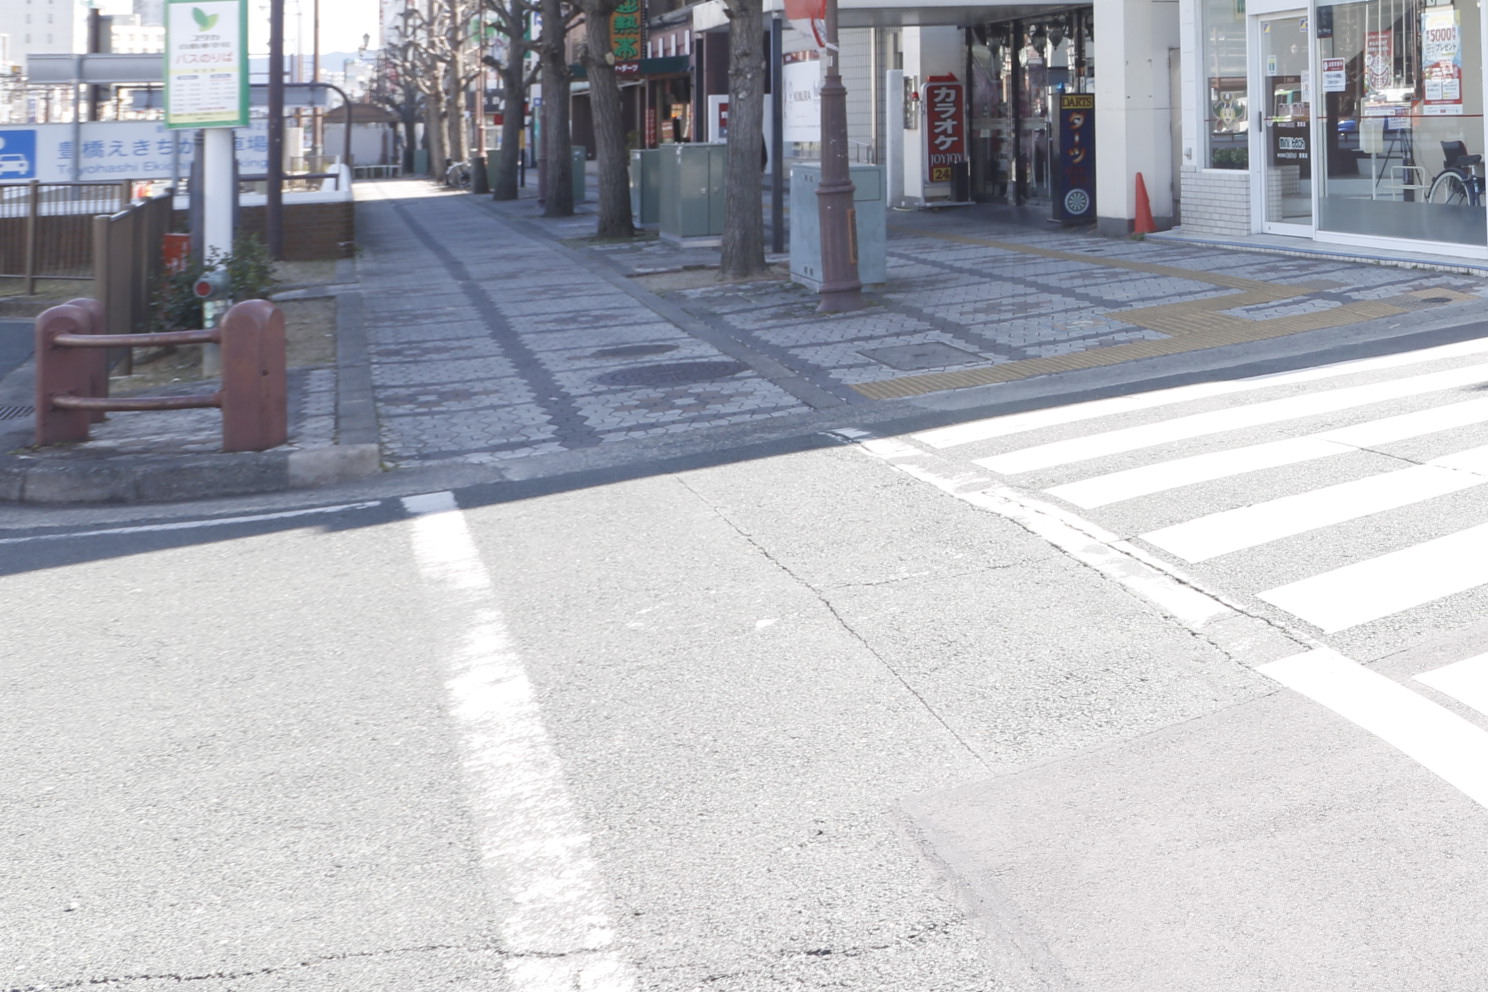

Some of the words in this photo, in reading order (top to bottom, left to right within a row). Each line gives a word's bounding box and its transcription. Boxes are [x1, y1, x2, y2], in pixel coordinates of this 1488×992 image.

[1430, 28, 1452, 43] 5000
[175, 52, 234, 64] バスのりば
[1061, 96, 1092, 107] DARTS
[934, 87, 958, 151] カラオケ
[1068, 111, 1086, 164] ダーツ
[930, 153, 963, 166] JOYJOY
